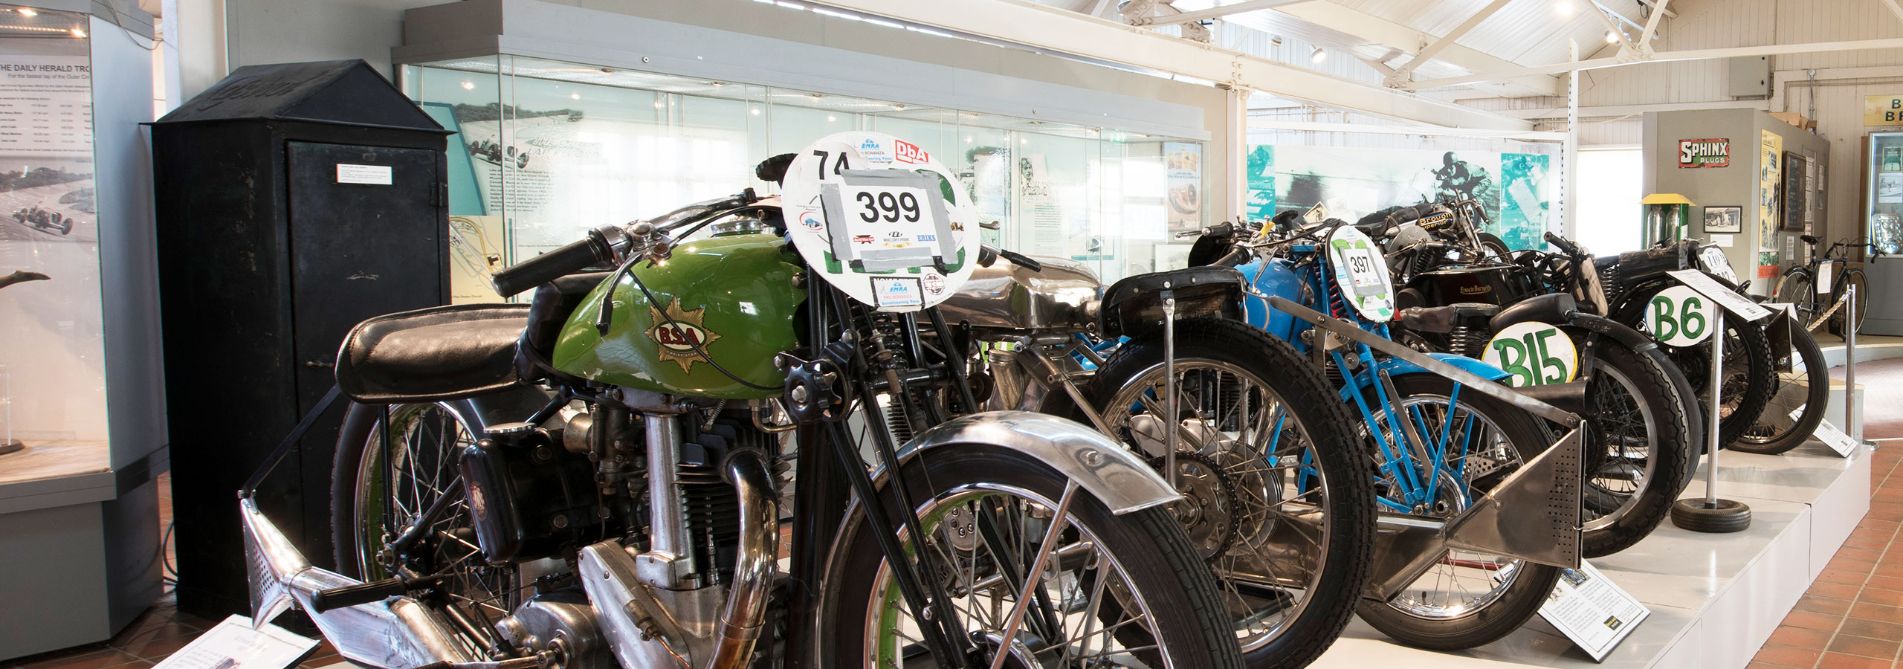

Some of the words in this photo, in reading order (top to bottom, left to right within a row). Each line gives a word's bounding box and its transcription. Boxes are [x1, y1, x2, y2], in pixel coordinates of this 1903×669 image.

[897, 141, 928, 162] DbA
[1680, 141, 1728, 163] SPHINX
[856, 191, 921, 224] 399
[1420, 212, 1452, 227] Brough
[1350, 256, 1371, 274] 397
[1651, 295, 1706, 342] B6
[659, 326, 701, 346] BSA
[1492, 328, 1568, 388] B15
